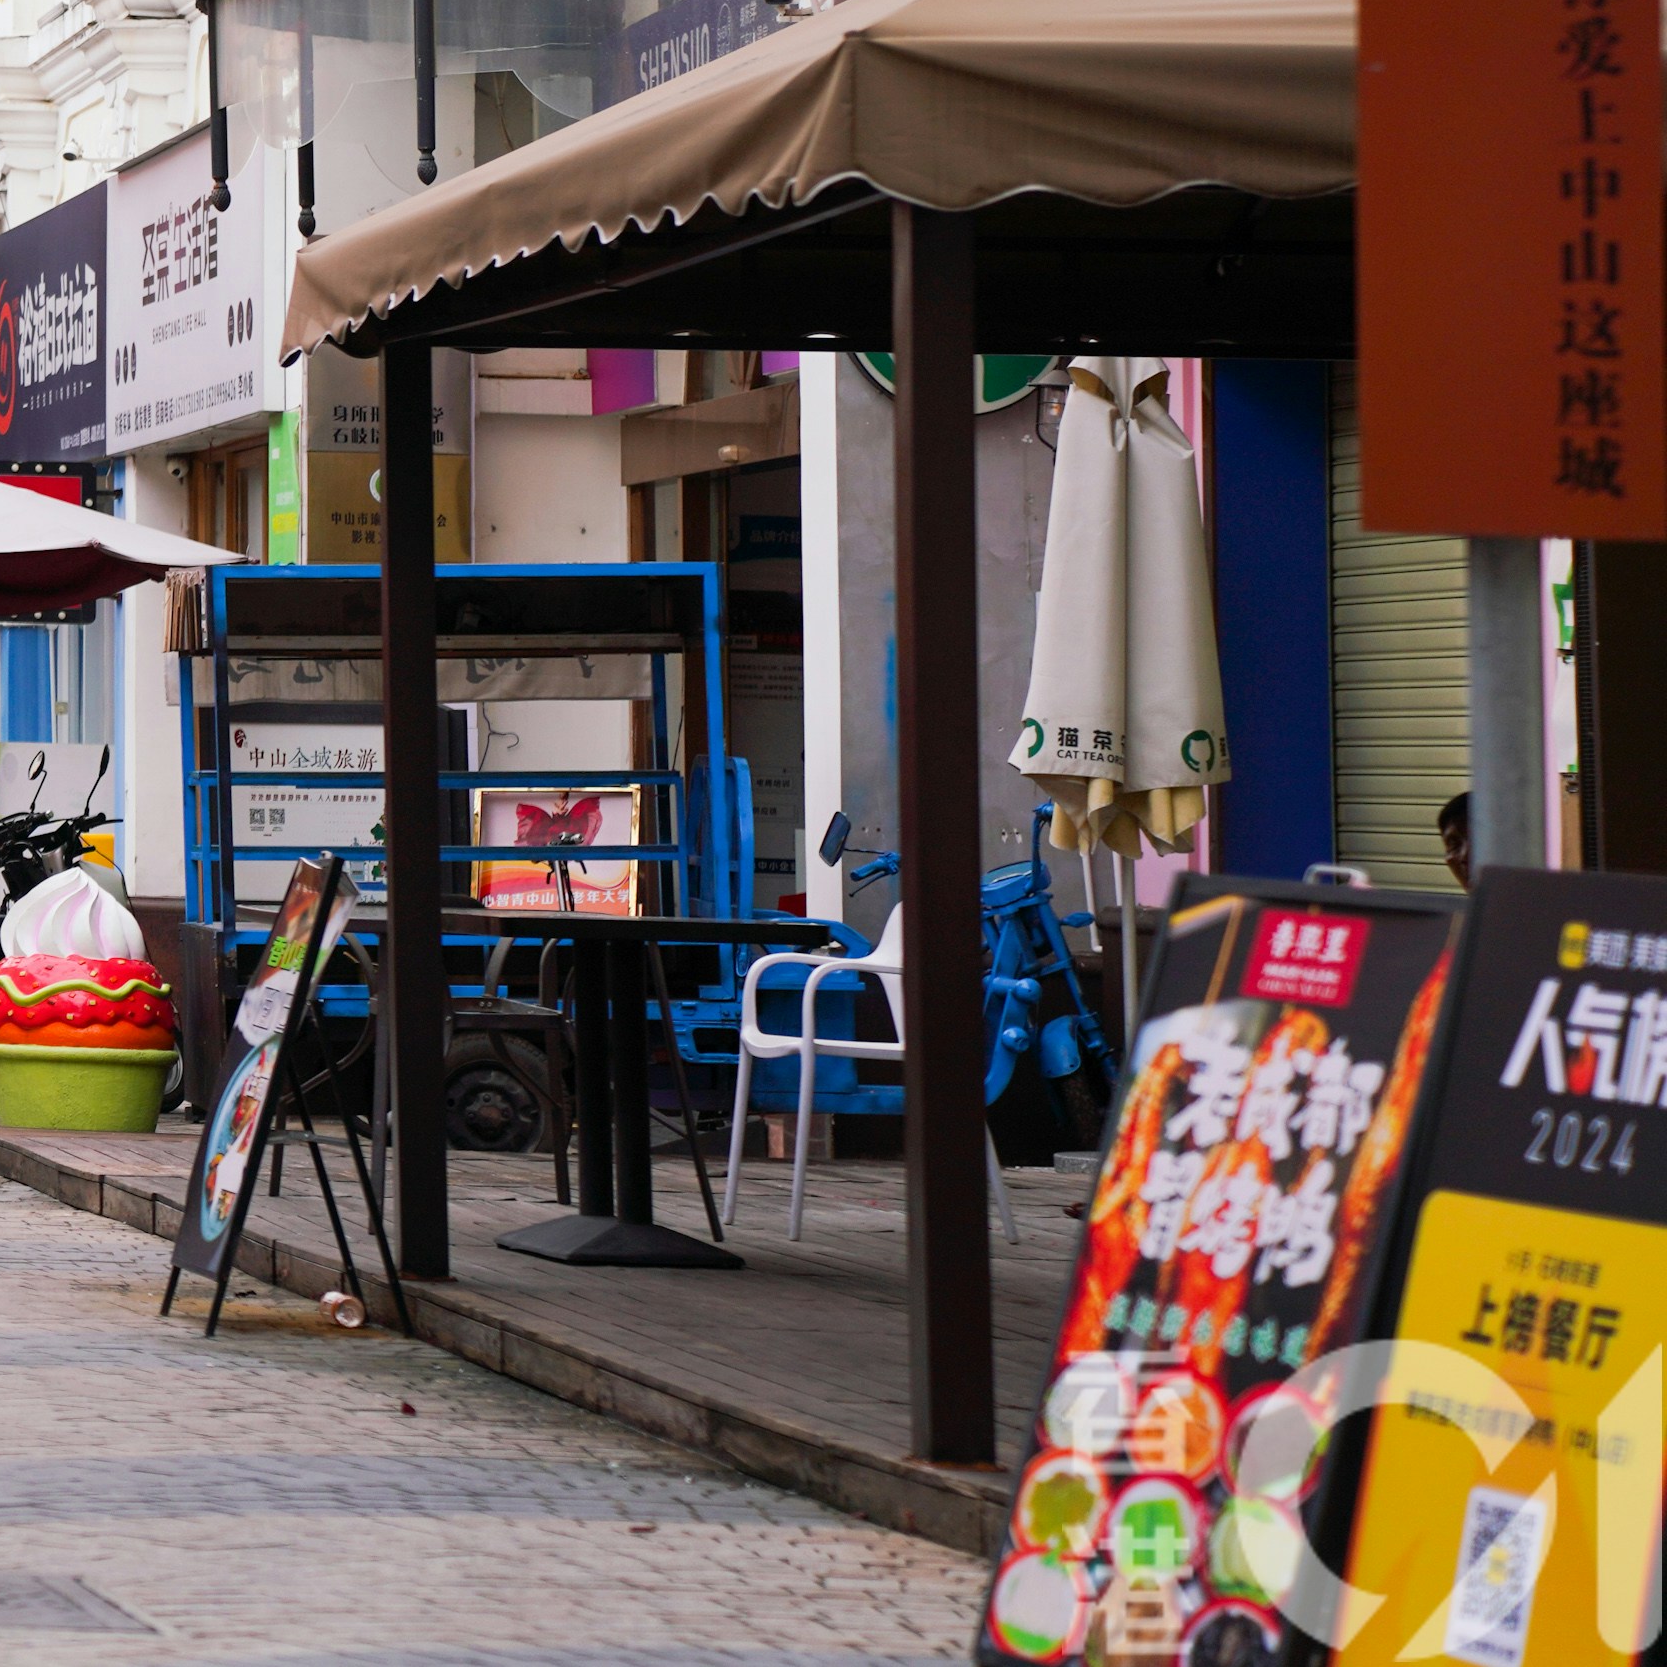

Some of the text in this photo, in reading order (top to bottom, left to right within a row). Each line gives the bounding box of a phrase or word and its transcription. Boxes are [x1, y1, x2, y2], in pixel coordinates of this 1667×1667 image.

[249, 746, 378, 771] 中山全域旅游
[1056, 750, 1079, 759] CAT
[1083, 751, 1104, 762] TEA
[1524, 1108, 1637, 1174] 2024
